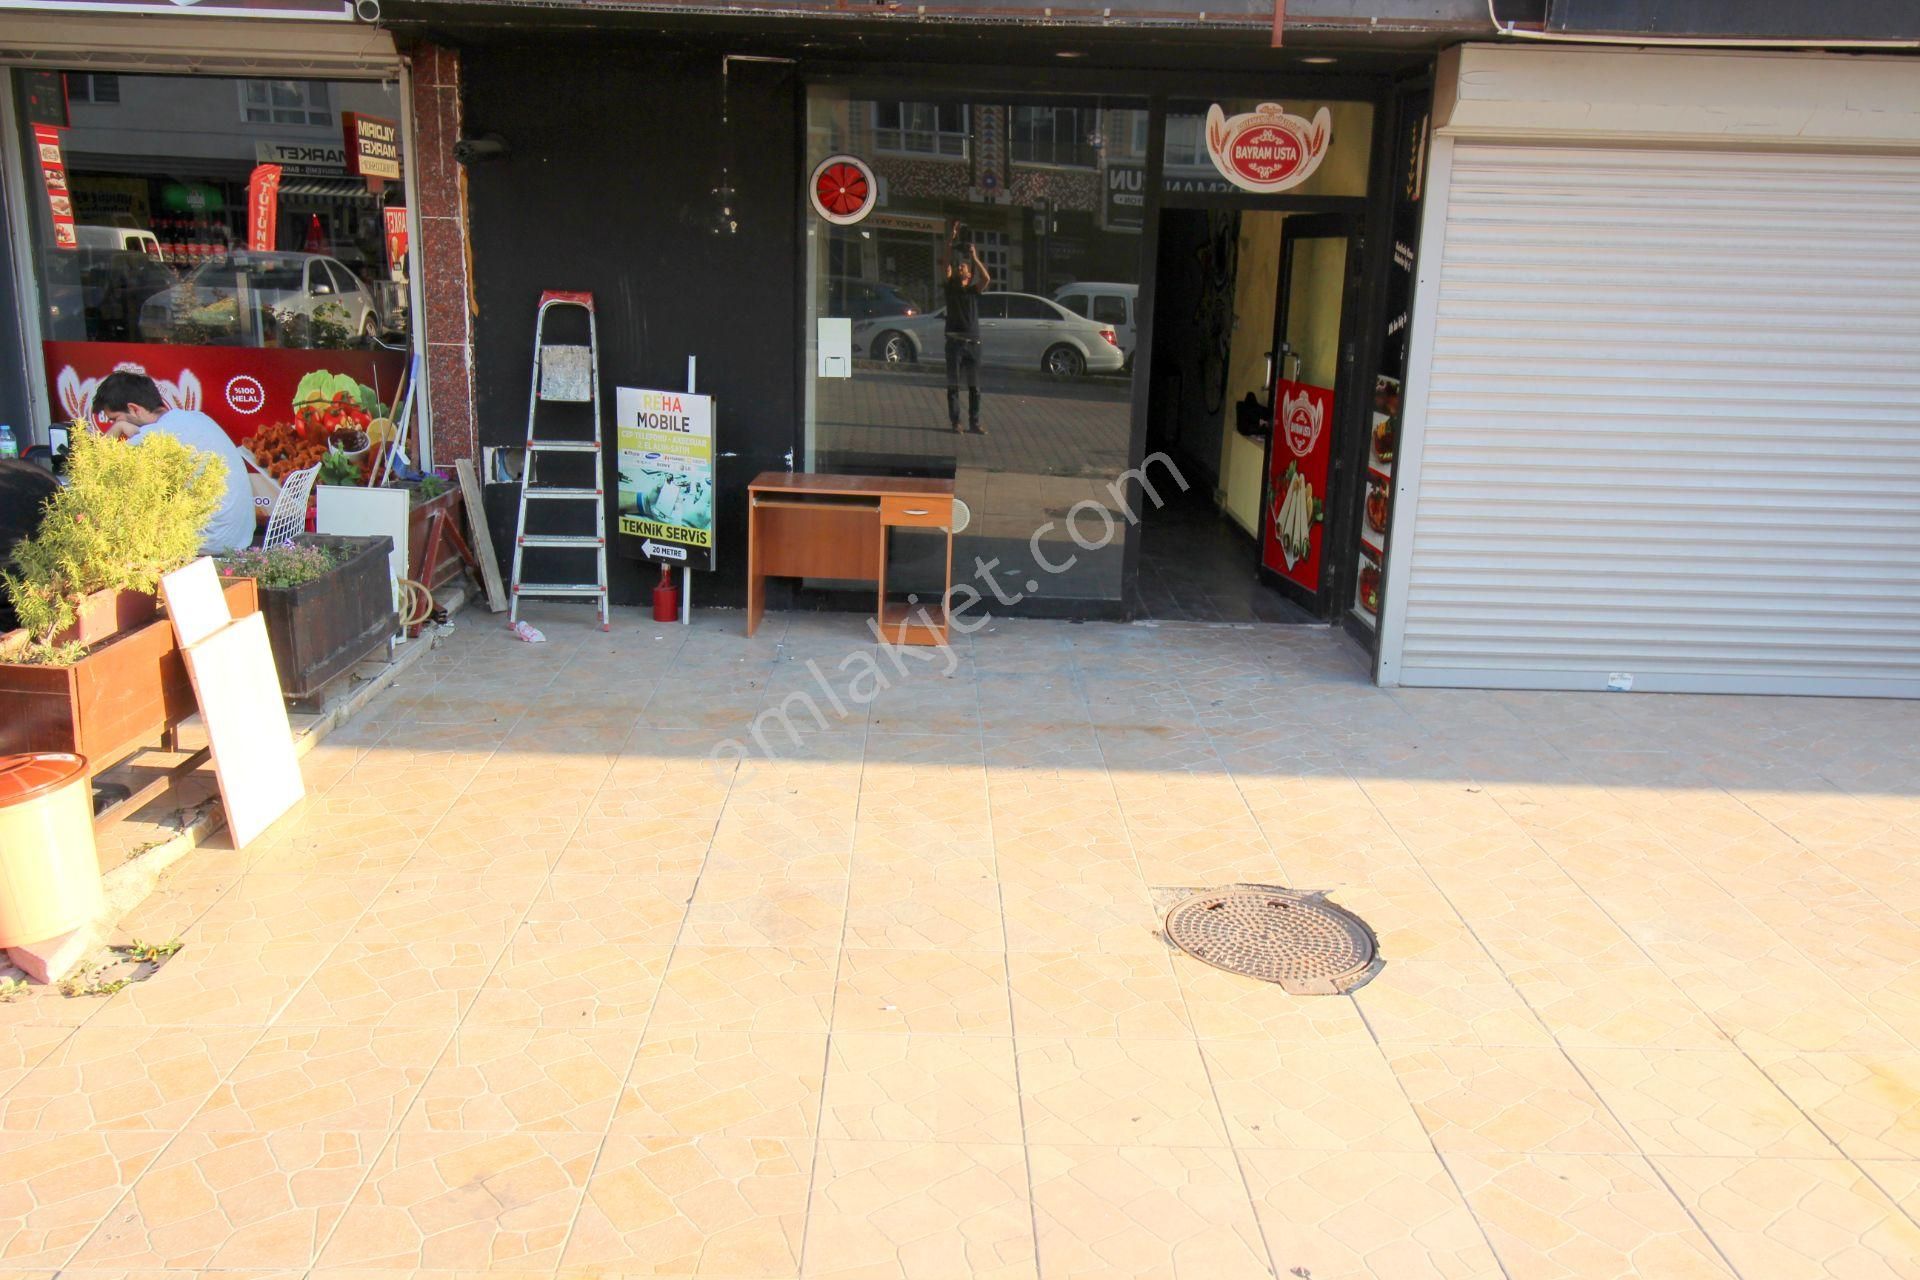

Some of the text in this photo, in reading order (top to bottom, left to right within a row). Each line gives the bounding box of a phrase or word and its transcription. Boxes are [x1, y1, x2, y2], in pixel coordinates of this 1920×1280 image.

[1235, 145, 1297, 161] BAYRAM USTA
[233, 387, 255, 395] %100
[232, 395, 259, 403] HELAL
[643, 394, 682, 413] REHA
[637, 412, 690, 432] MOBILE
[652, 546, 682, 558] 20 METRE
